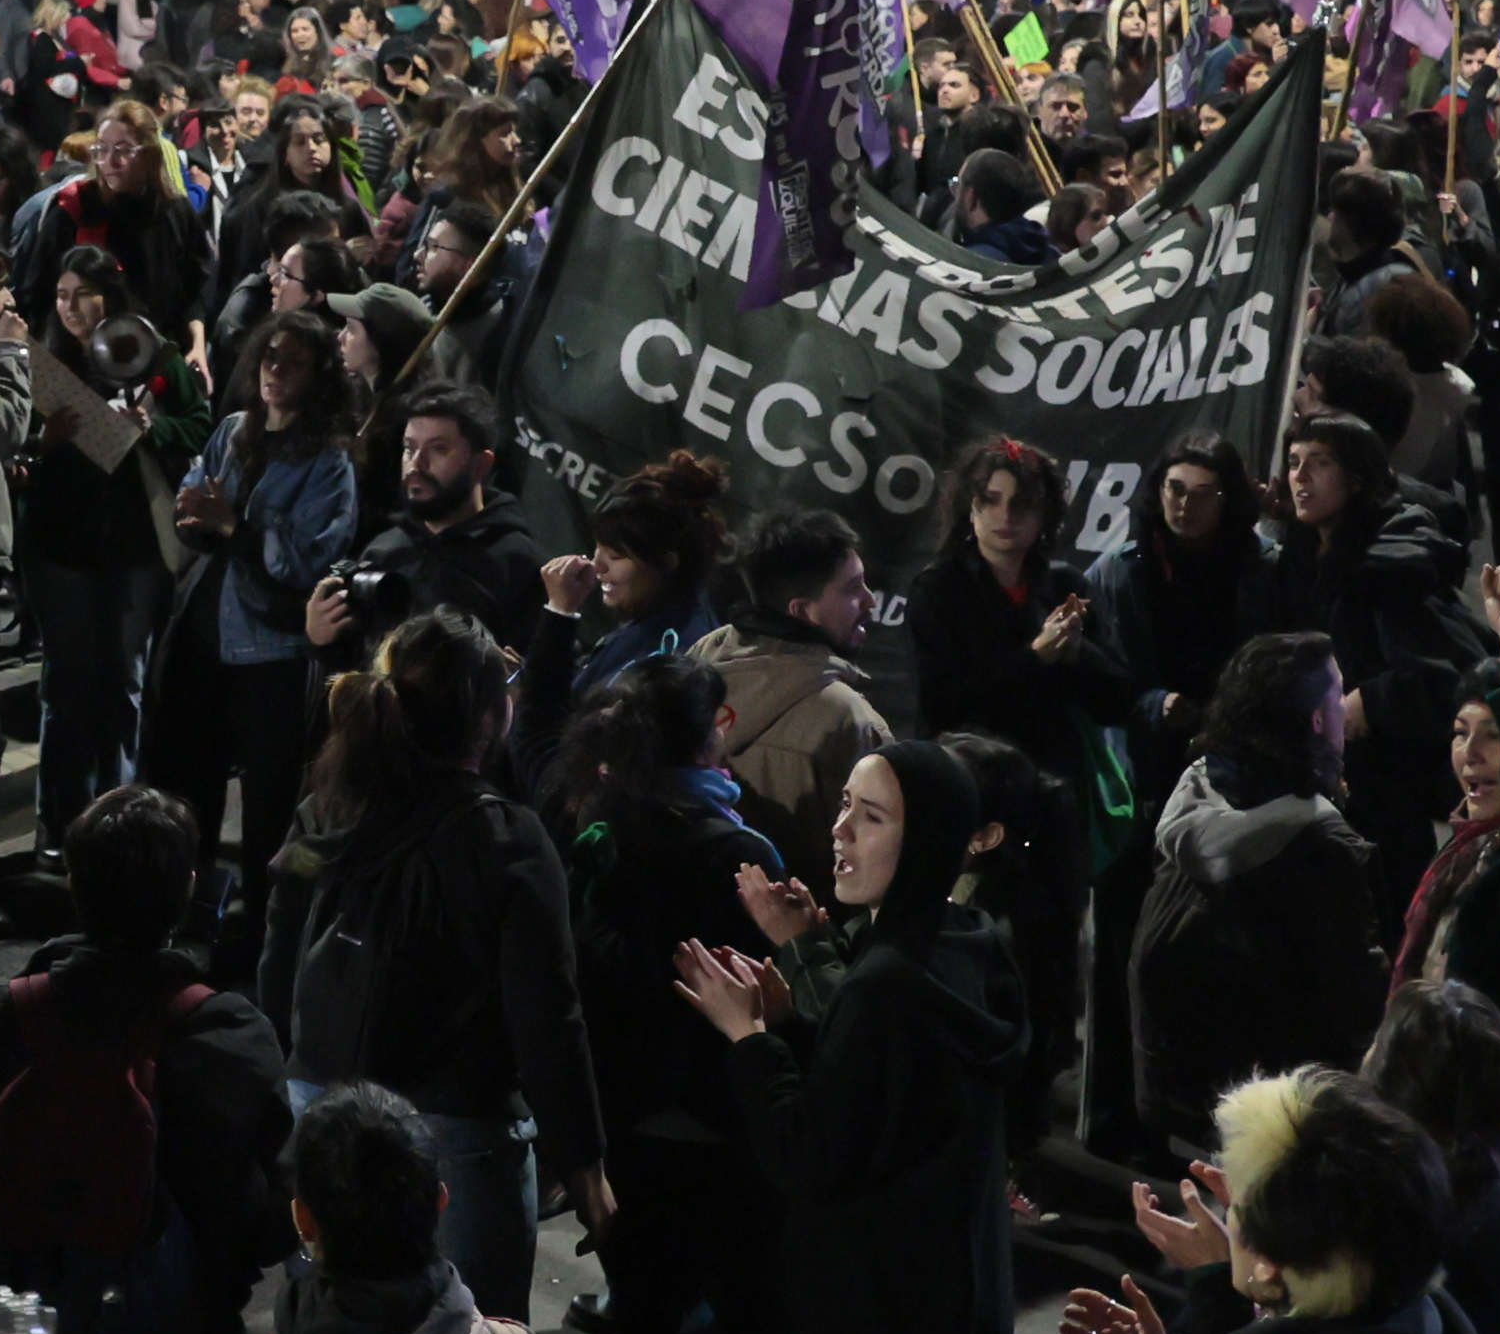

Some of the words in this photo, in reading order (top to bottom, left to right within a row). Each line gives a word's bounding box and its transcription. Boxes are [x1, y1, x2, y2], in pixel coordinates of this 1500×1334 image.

[591, 136, 979, 369] CIENIAS
[974, 290, 1274, 410] SOCIALES
[619, 318, 936, 515] CECSO
